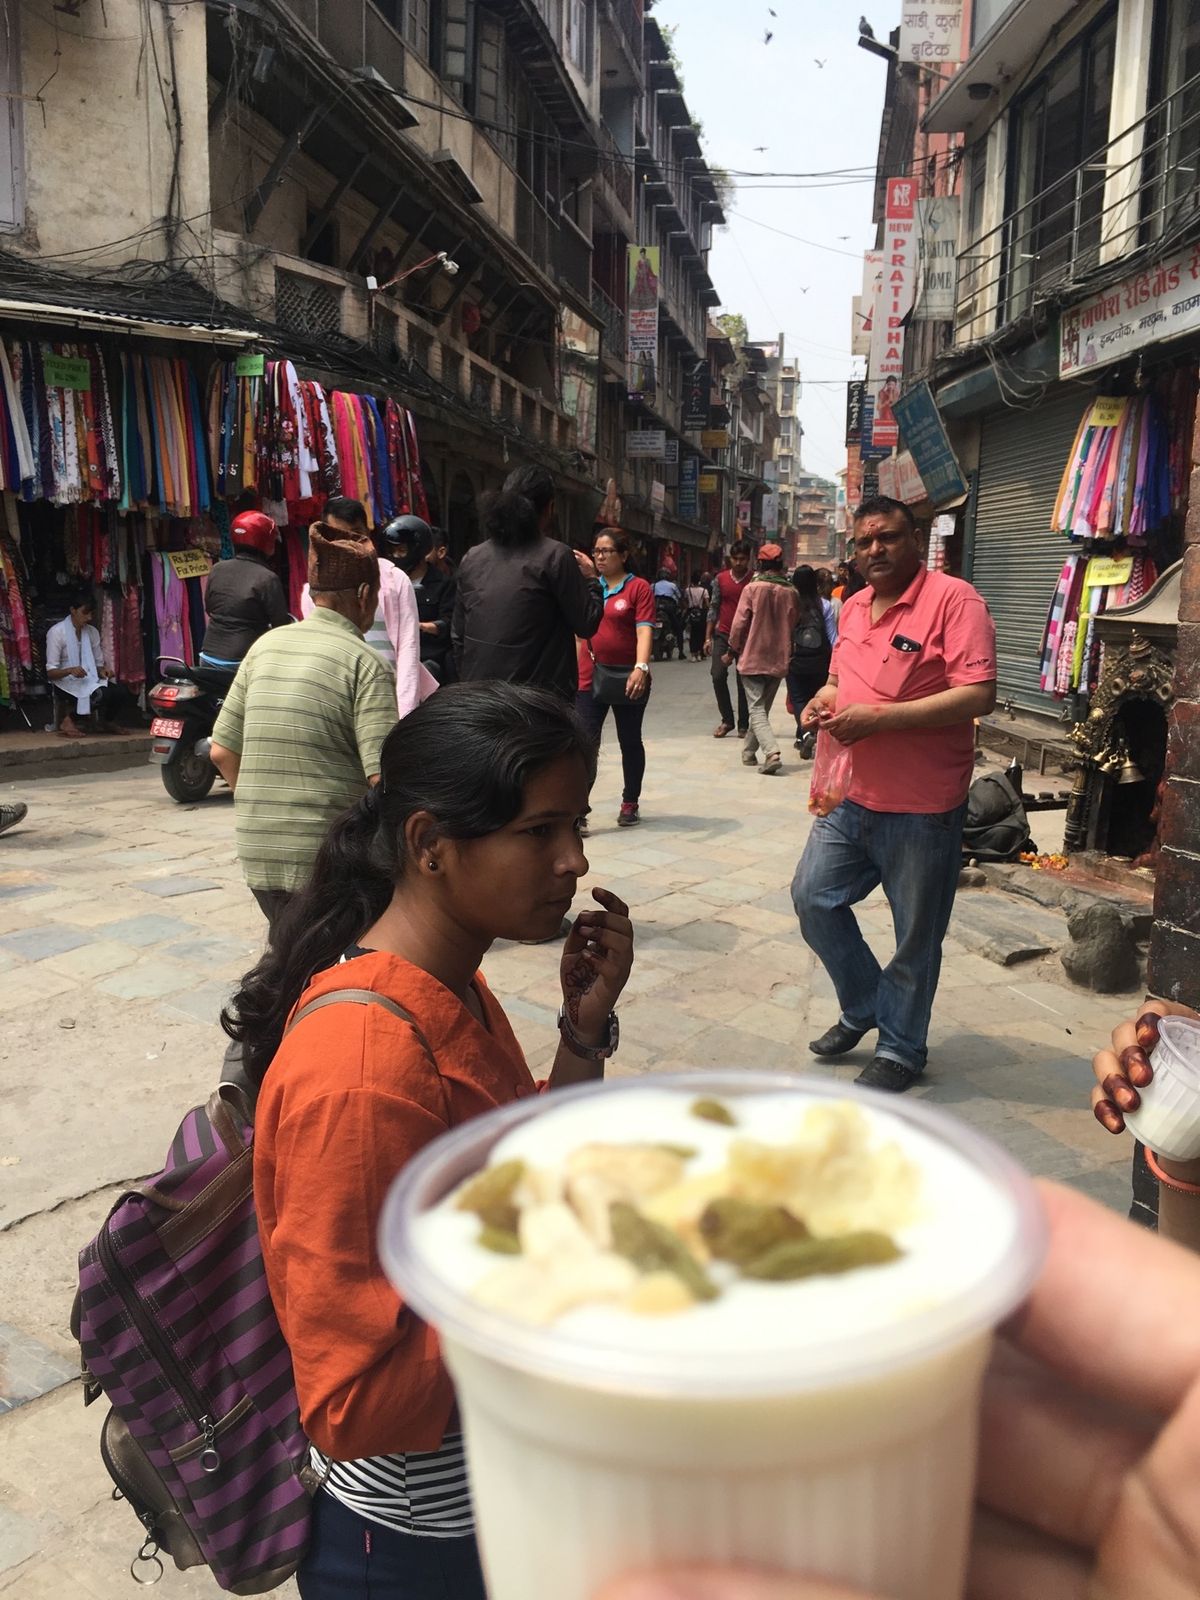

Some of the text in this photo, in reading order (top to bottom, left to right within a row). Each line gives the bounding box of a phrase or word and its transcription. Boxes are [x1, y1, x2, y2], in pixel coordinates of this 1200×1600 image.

[911, 41, 951, 61] बुटिक
[888, 223, 912, 233] NEW
[923, 267, 953, 290] HOME
[885, 238, 906, 359] PRATIBHA
[1081, 292, 1121, 329] गणेश
[176, 563, 209, 574] Fix Price
